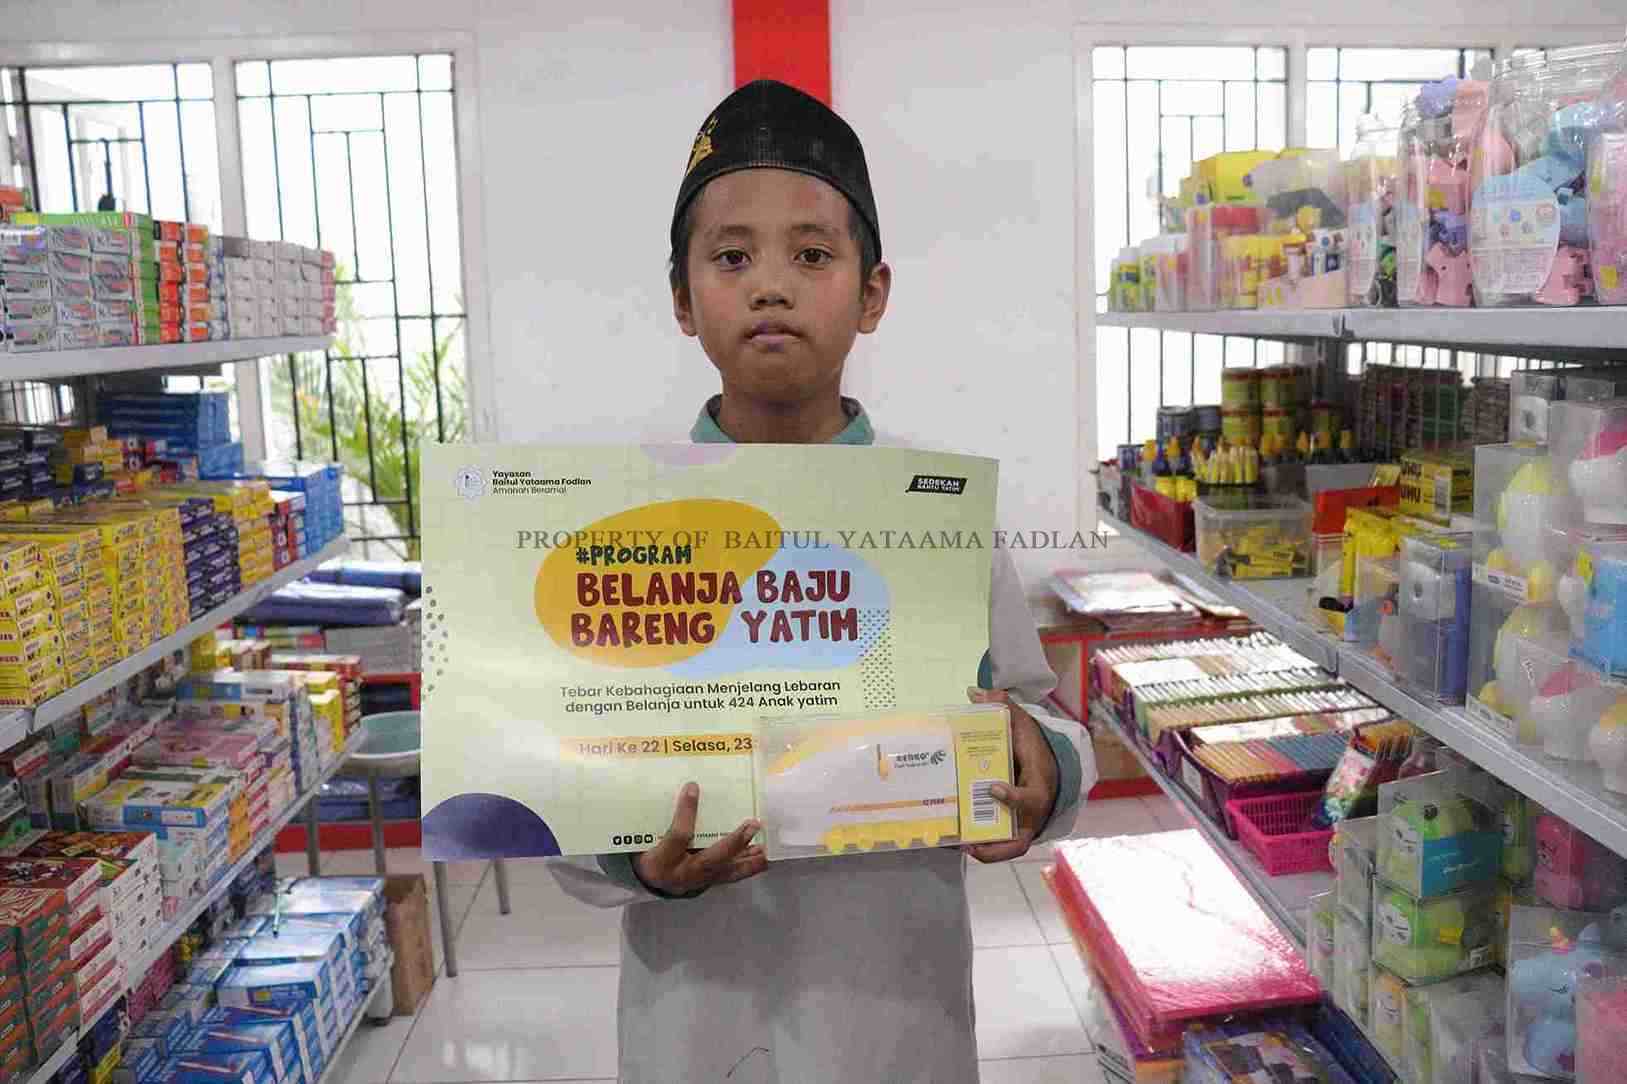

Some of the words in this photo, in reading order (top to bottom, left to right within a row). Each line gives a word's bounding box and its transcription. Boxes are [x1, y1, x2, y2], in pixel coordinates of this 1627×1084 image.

[492, 470, 532, 479] Yayasan
[575, 545, 692, 566] #PROGRAM
[576, 571, 743, 607] BELANJA
[756, 569, 851, 603] BAJU
[571, 611, 715, 647] BARENG
[740, 607, 859, 643] YATIM
[560, 685, 602, 698] Tebar
[605, 683, 704, 701] Kebahagiaan
[707, 680, 781, 697] Menjelang
[783, 679, 841, 692] Lebaran
[565, 701, 622, 715] dengan
[626, 698, 681, 713] Belanja
[684, 697, 725, 710] untuk
[728, 697, 755, 709] 424
[758, 695, 794, 708] Anak
[797, 694, 838, 708] yatim
[579, 742, 614, 755] Hari
[617, 741, 637, 755] Ke
[642, 740, 660, 753] 22
[672, 739, 731, 753] Selasa,
[734, 737, 752, 750] 23
